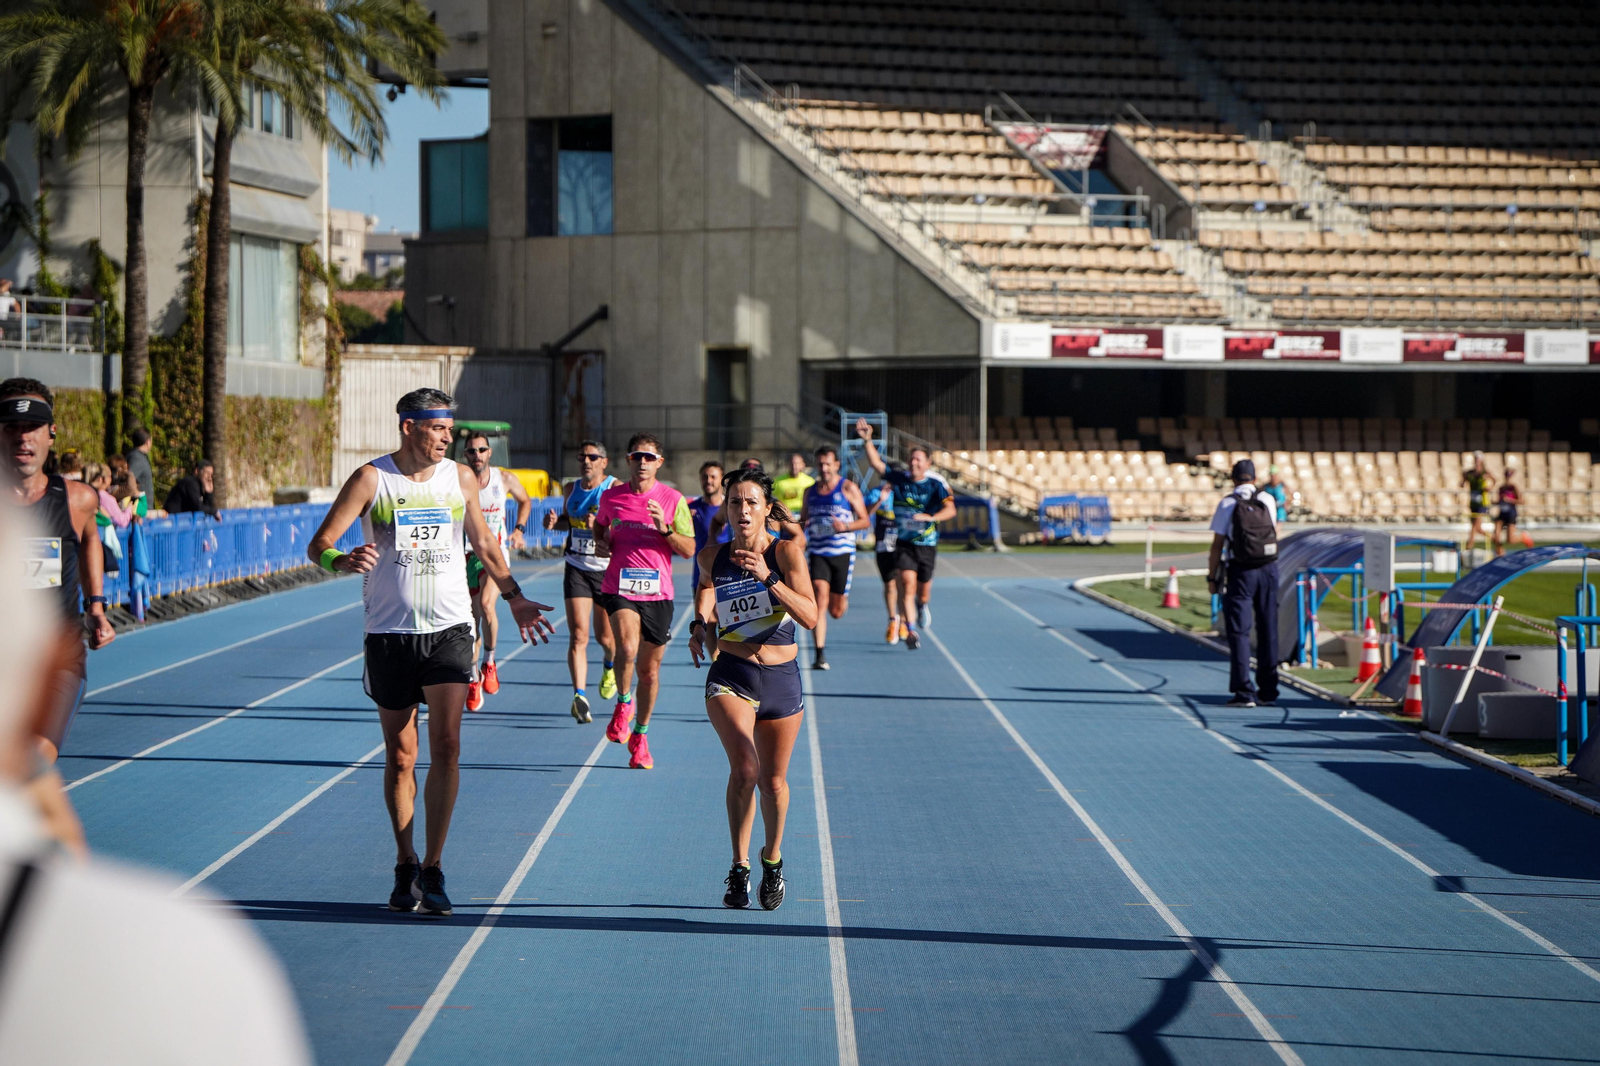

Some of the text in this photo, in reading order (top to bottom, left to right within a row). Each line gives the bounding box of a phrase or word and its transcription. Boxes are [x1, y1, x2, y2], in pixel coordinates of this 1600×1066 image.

[410, 525, 440, 540] 437
[394, 550, 450, 567] Los Olivos
[629, 580, 651, 590] 719
[729, 595, 760, 614] 402
